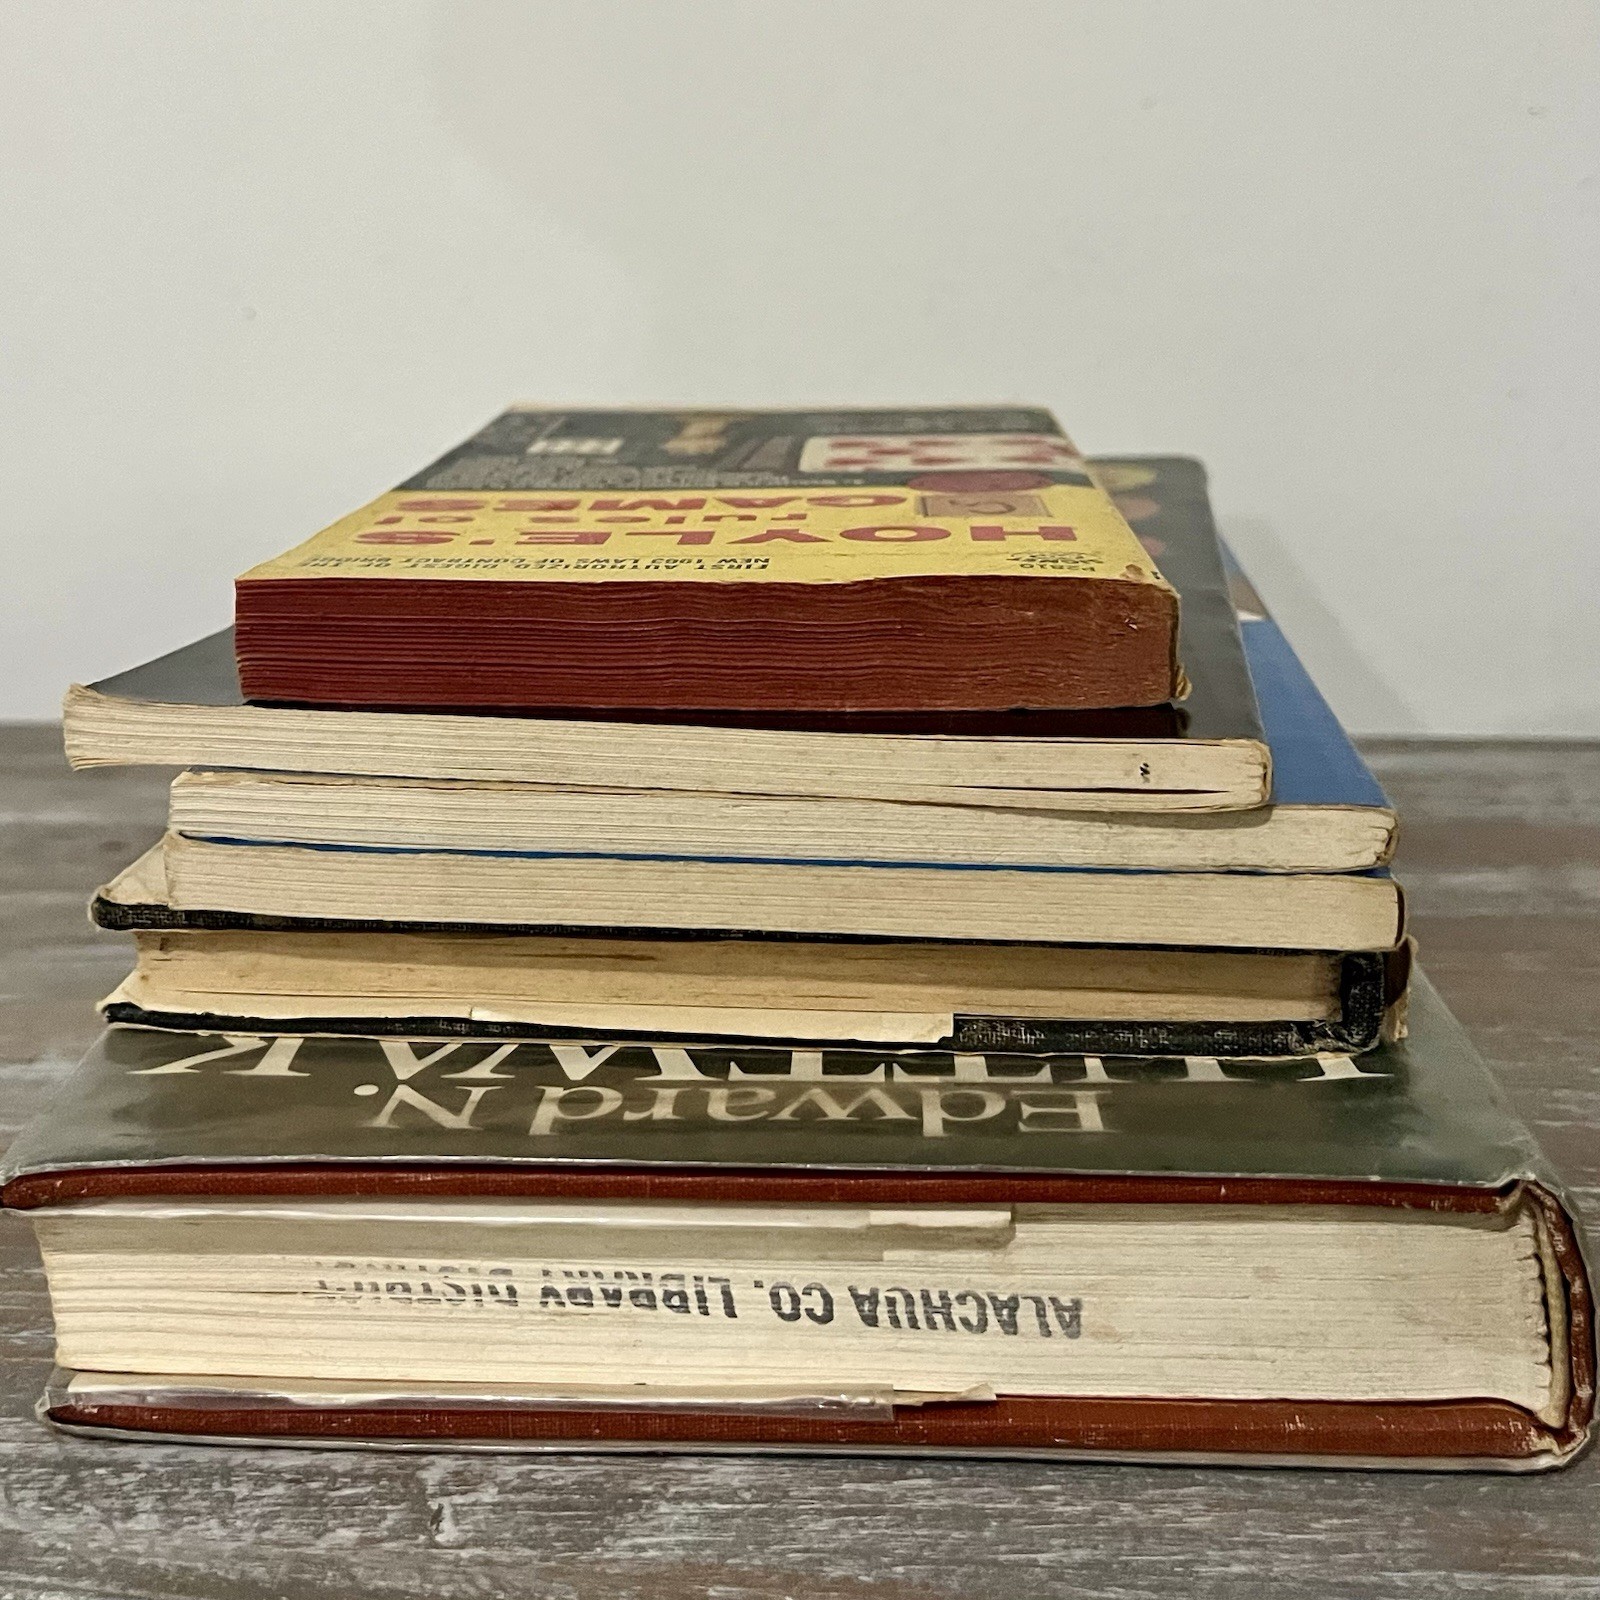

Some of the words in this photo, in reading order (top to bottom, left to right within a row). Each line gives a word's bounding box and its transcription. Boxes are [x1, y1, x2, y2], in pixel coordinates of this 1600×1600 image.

[394, 494, 908, 512] GAMES
[530, 513, 808, 525] rules
[352, 525, 1078, 545] HOYLE'S
[125, 1035, 1396, 1083] TTWAK
[353, 1084, 503, 1130] N.
[528, 1086, 1122, 1137] Edward
[538, 1268, 739, 1319] LIBRARY
[753, 1280, 835, 1325] CO.
[847, 1285, 1083, 1339] ALACHUA
